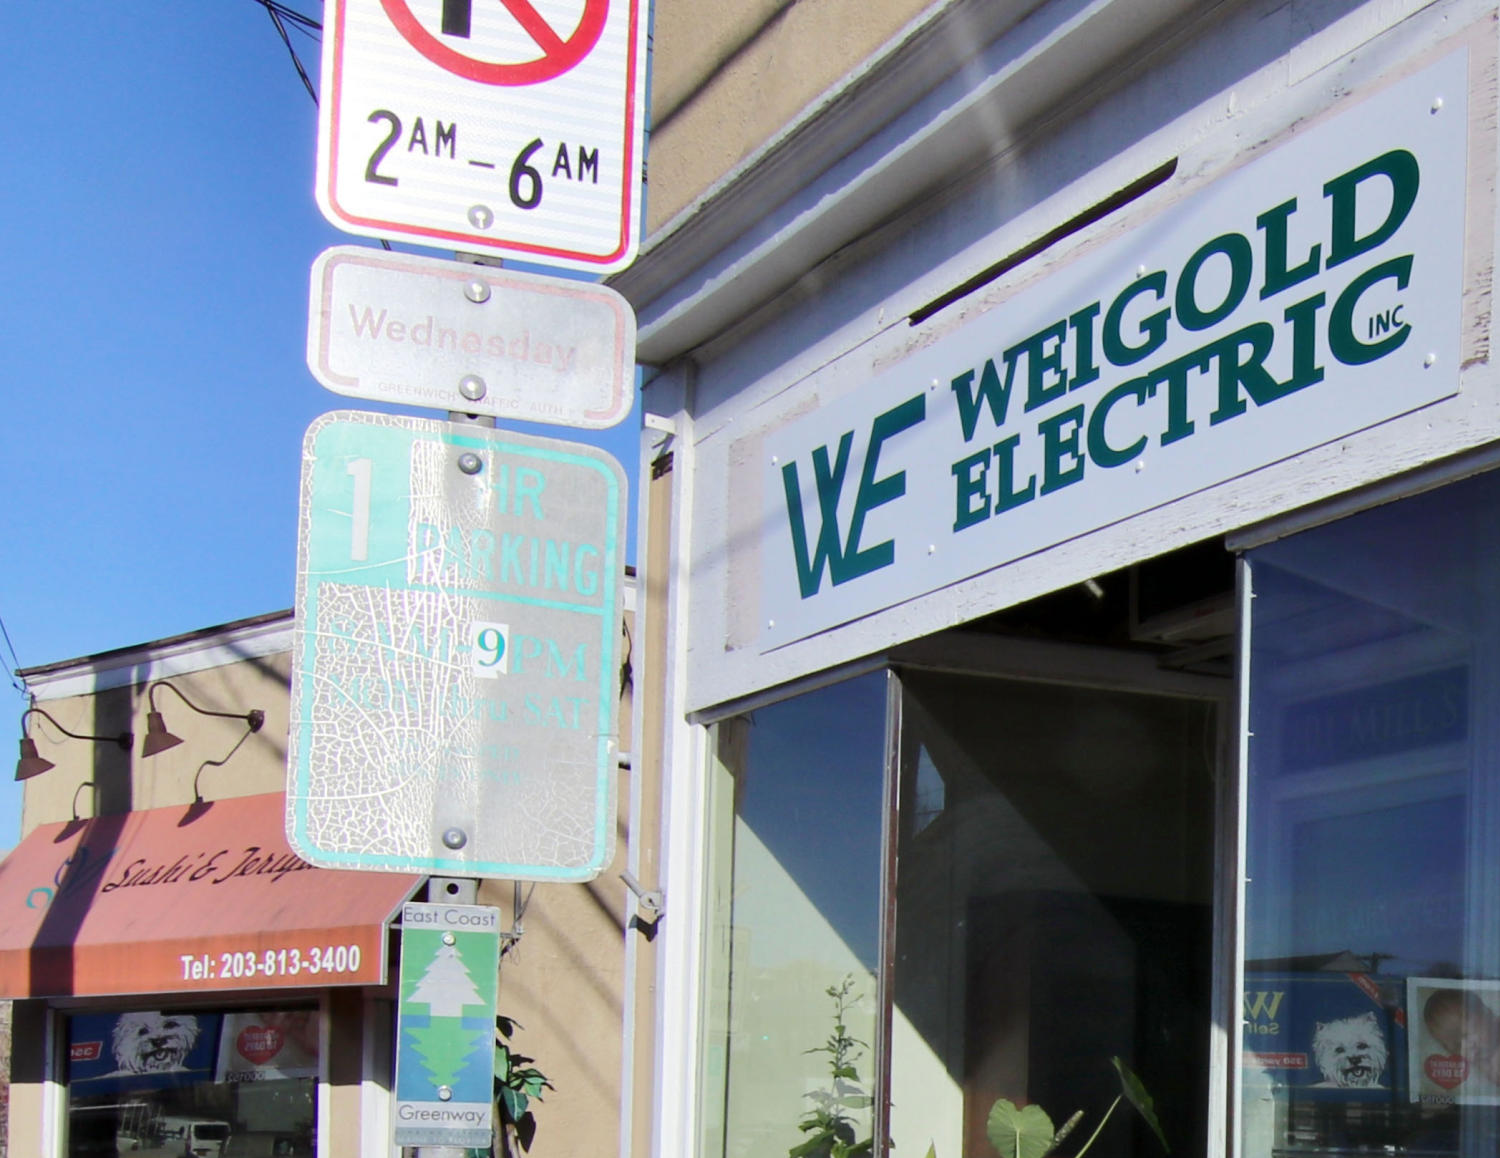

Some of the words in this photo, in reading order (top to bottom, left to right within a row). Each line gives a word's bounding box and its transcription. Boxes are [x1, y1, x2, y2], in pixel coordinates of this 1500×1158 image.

[951, 148, 1420, 442] WEIGOLD
[348, 303, 577, 373] Wednesday
[1368, 304, 1404, 340] INC
[378, 383, 455, 401] GREENWICH
[952, 254, 1415, 533] ELECTRIC
[346, 456, 373, 562] 1
[416, 522, 600, 597] PARKING
[523, 691, 591, 731] SAT
[102, 852, 204, 892] Sushi
[403, 906, 438, 924] East
[444, 908, 496, 927] Coast
[181, 954, 215, 980] Tel:
[220, 945, 361, 978] 203-813-3400
[399, 1104, 486, 1125] Greenway
